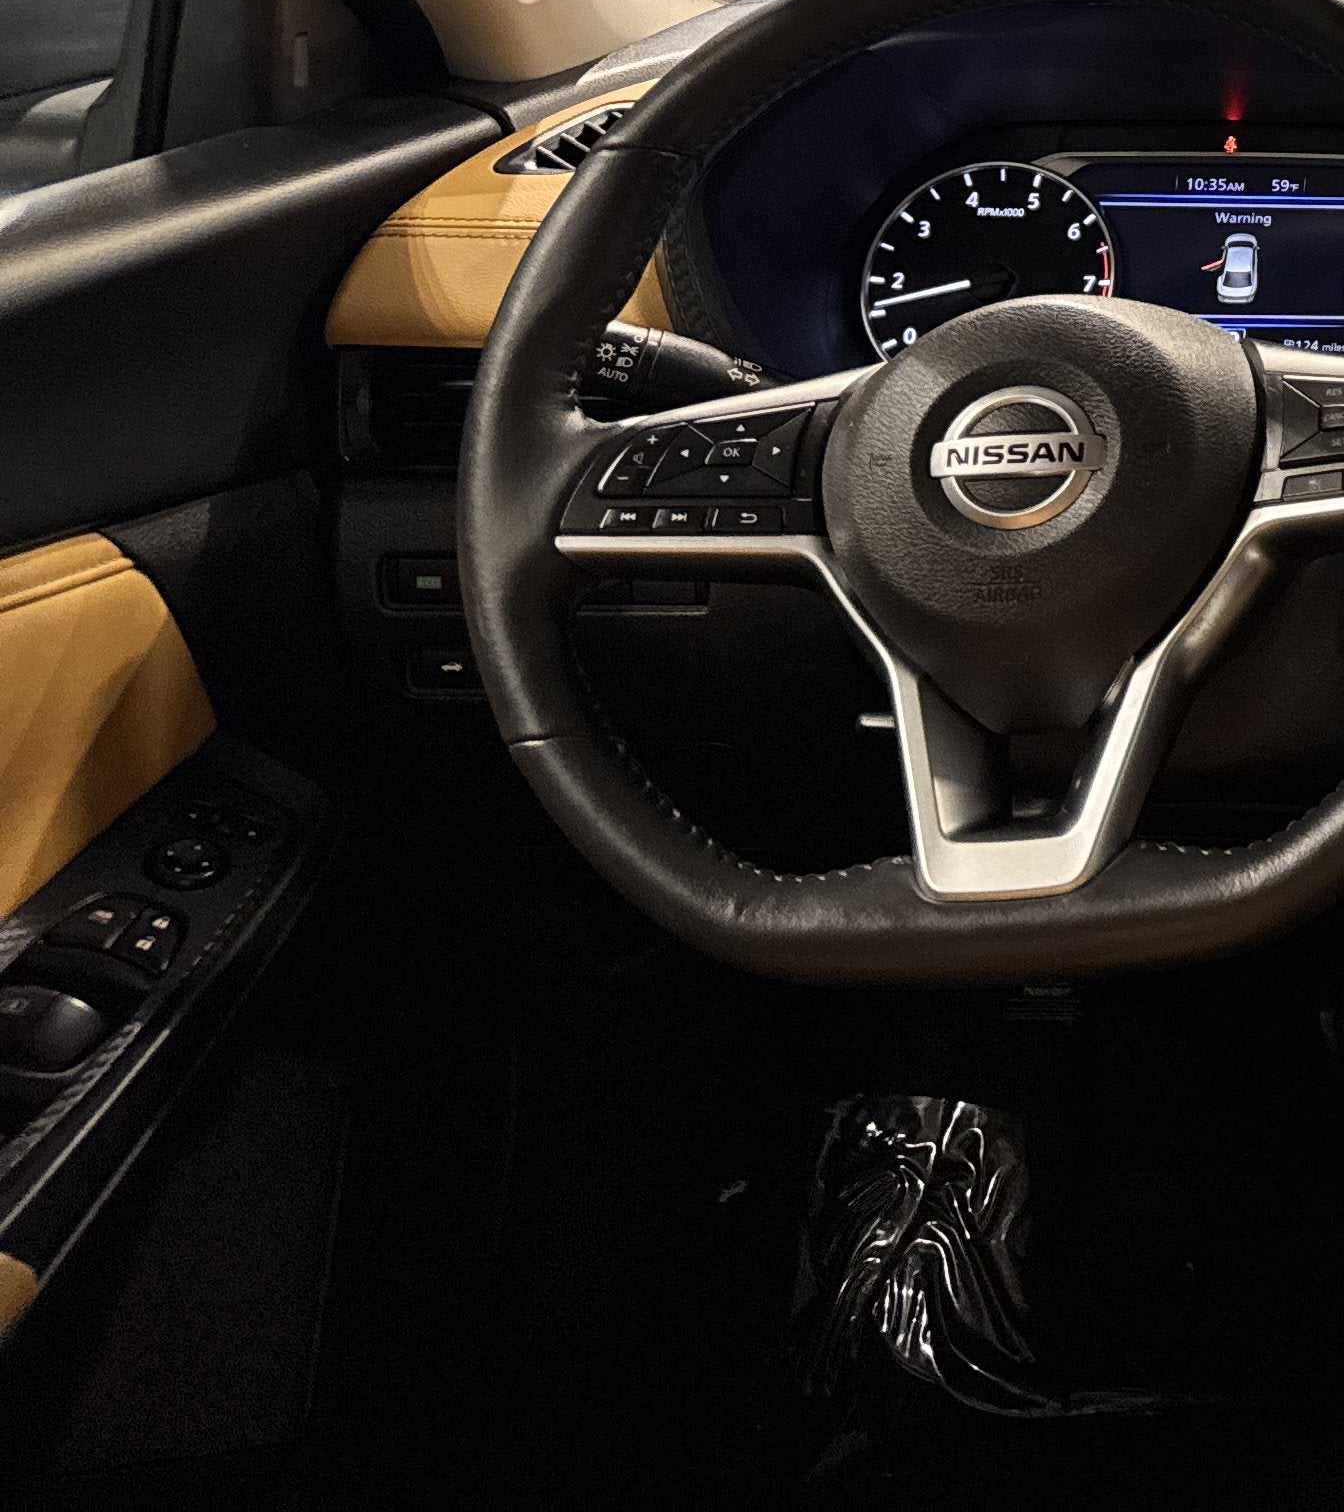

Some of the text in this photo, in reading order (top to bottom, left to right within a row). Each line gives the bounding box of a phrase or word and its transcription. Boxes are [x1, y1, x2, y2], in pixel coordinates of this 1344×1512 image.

[965, 191, 980, 208] 4
[1027, 192, 1041, 210] 5
[1214, 211, 1272, 226] Warning
[918, 220, 931, 238] 3
[1067, 223, 1081, 240] 6
[890, 272, 905, 289] 2
[1082, 275, 1096, 292] 7
[902, 327, 917, 345] 0
[598, 366, 629, 383] AUTO
[723, 448, 741, 458] OK
[946, 442, 1085, 468] NISSAN
